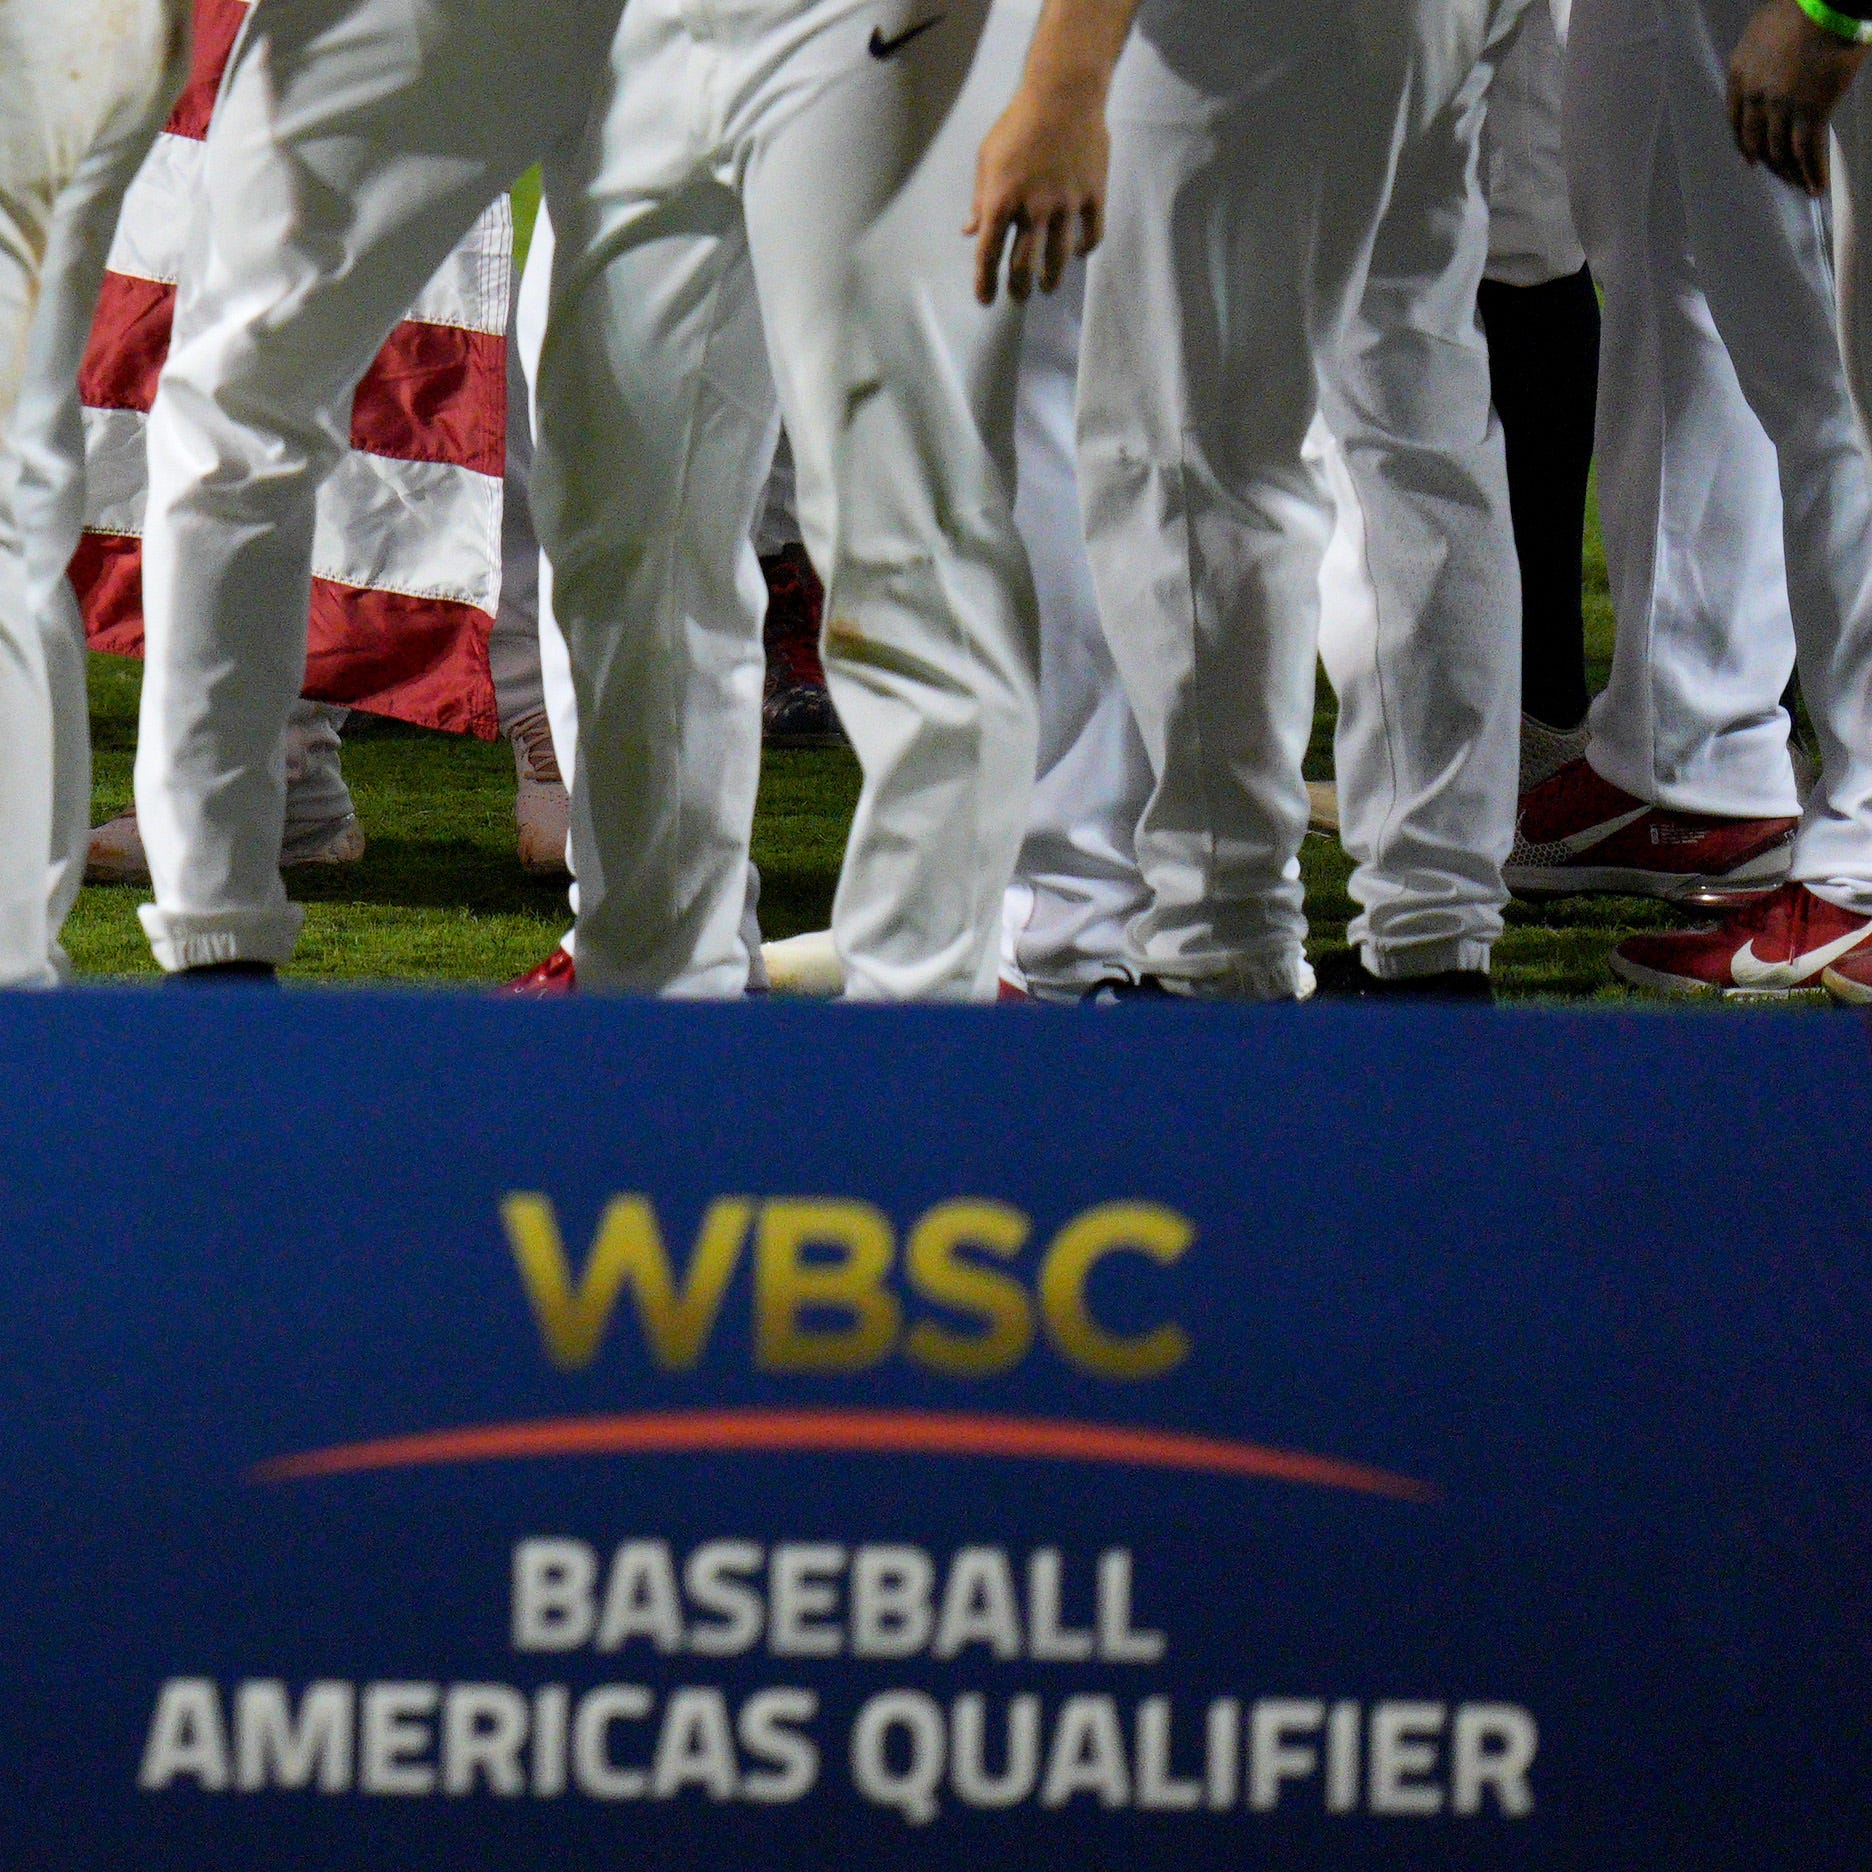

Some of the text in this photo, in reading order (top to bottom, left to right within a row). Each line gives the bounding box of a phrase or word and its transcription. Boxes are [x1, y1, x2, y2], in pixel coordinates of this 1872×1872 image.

[501, 1191, 1194, 1378] WBSC
[511, 1539, 1165, 1660] BASEBALL
[139, 1678, 1539, 1826] AMERICAS QUALIFIER
